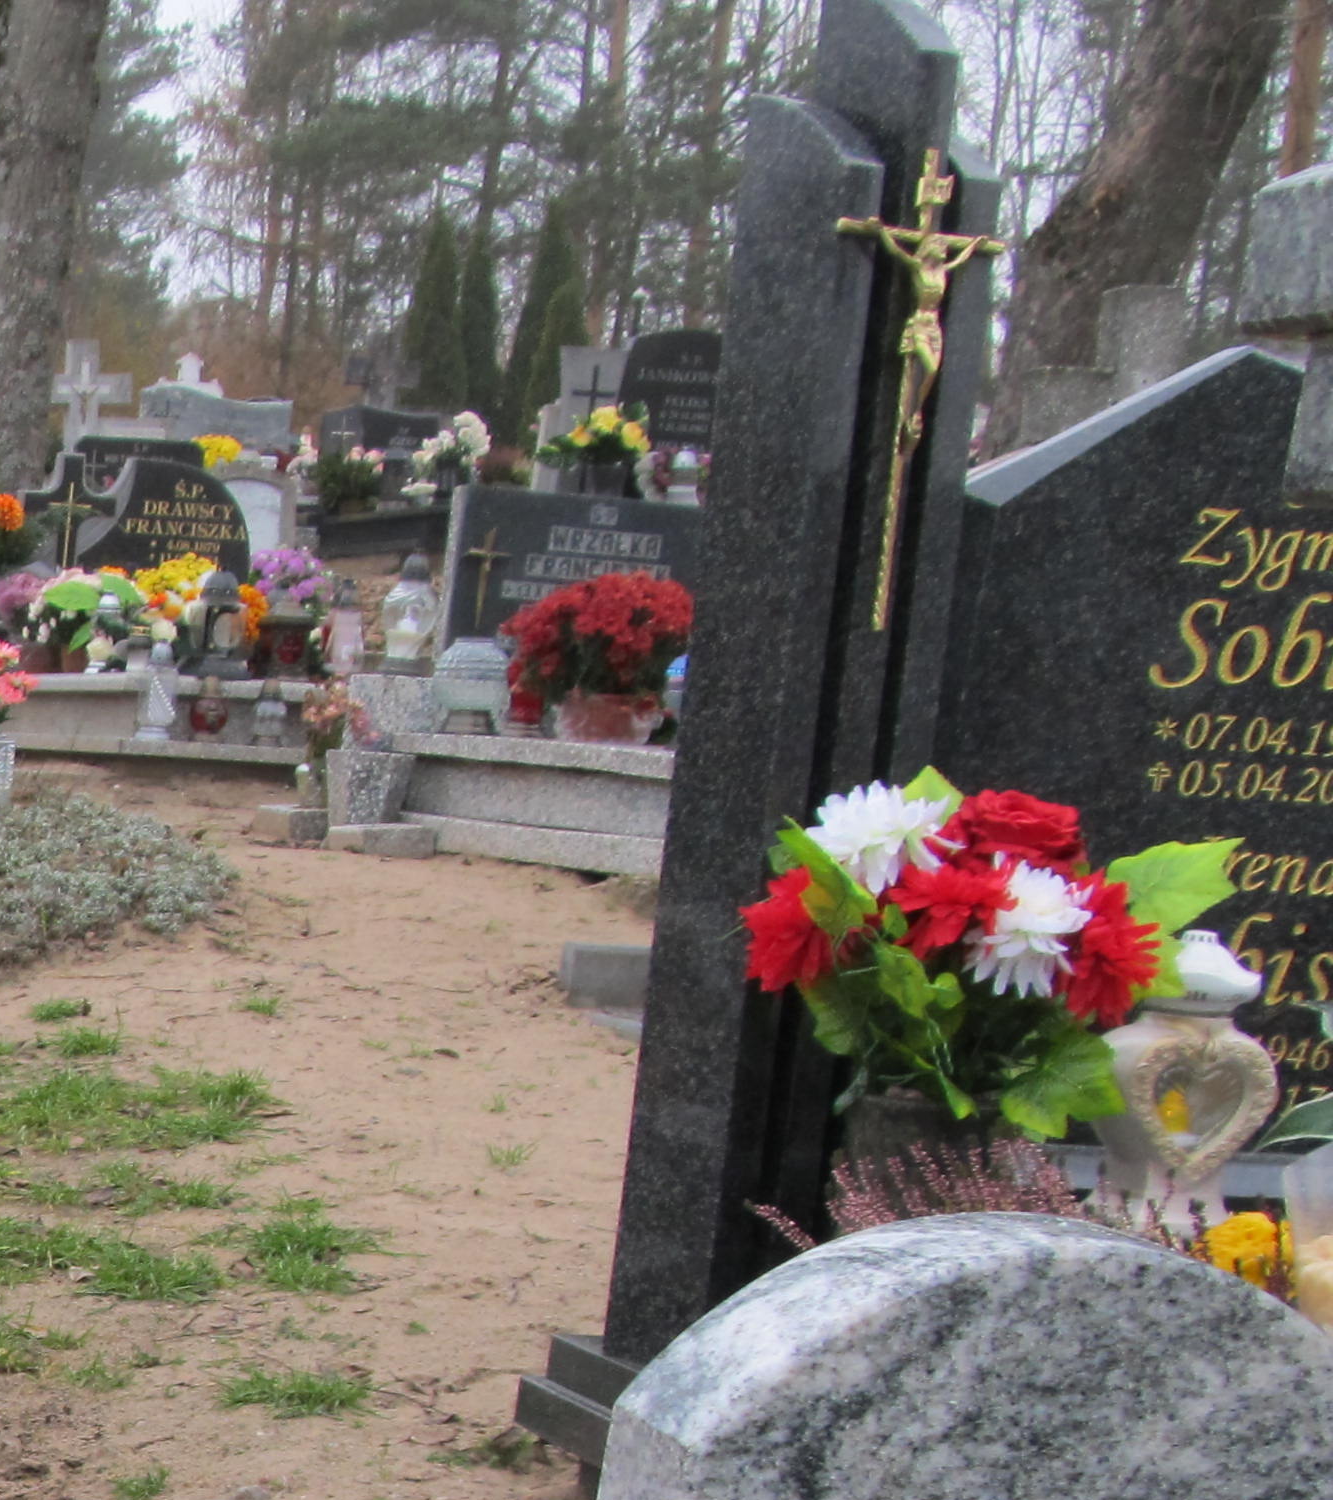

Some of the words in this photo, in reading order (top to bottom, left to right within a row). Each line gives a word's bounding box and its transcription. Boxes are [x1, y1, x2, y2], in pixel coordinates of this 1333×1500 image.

[143, 500, 233, 522] DRAWSCY
[124, 518, 247, 541] FRANCISZKA
[1148, 592, 1333, 691] Sob
